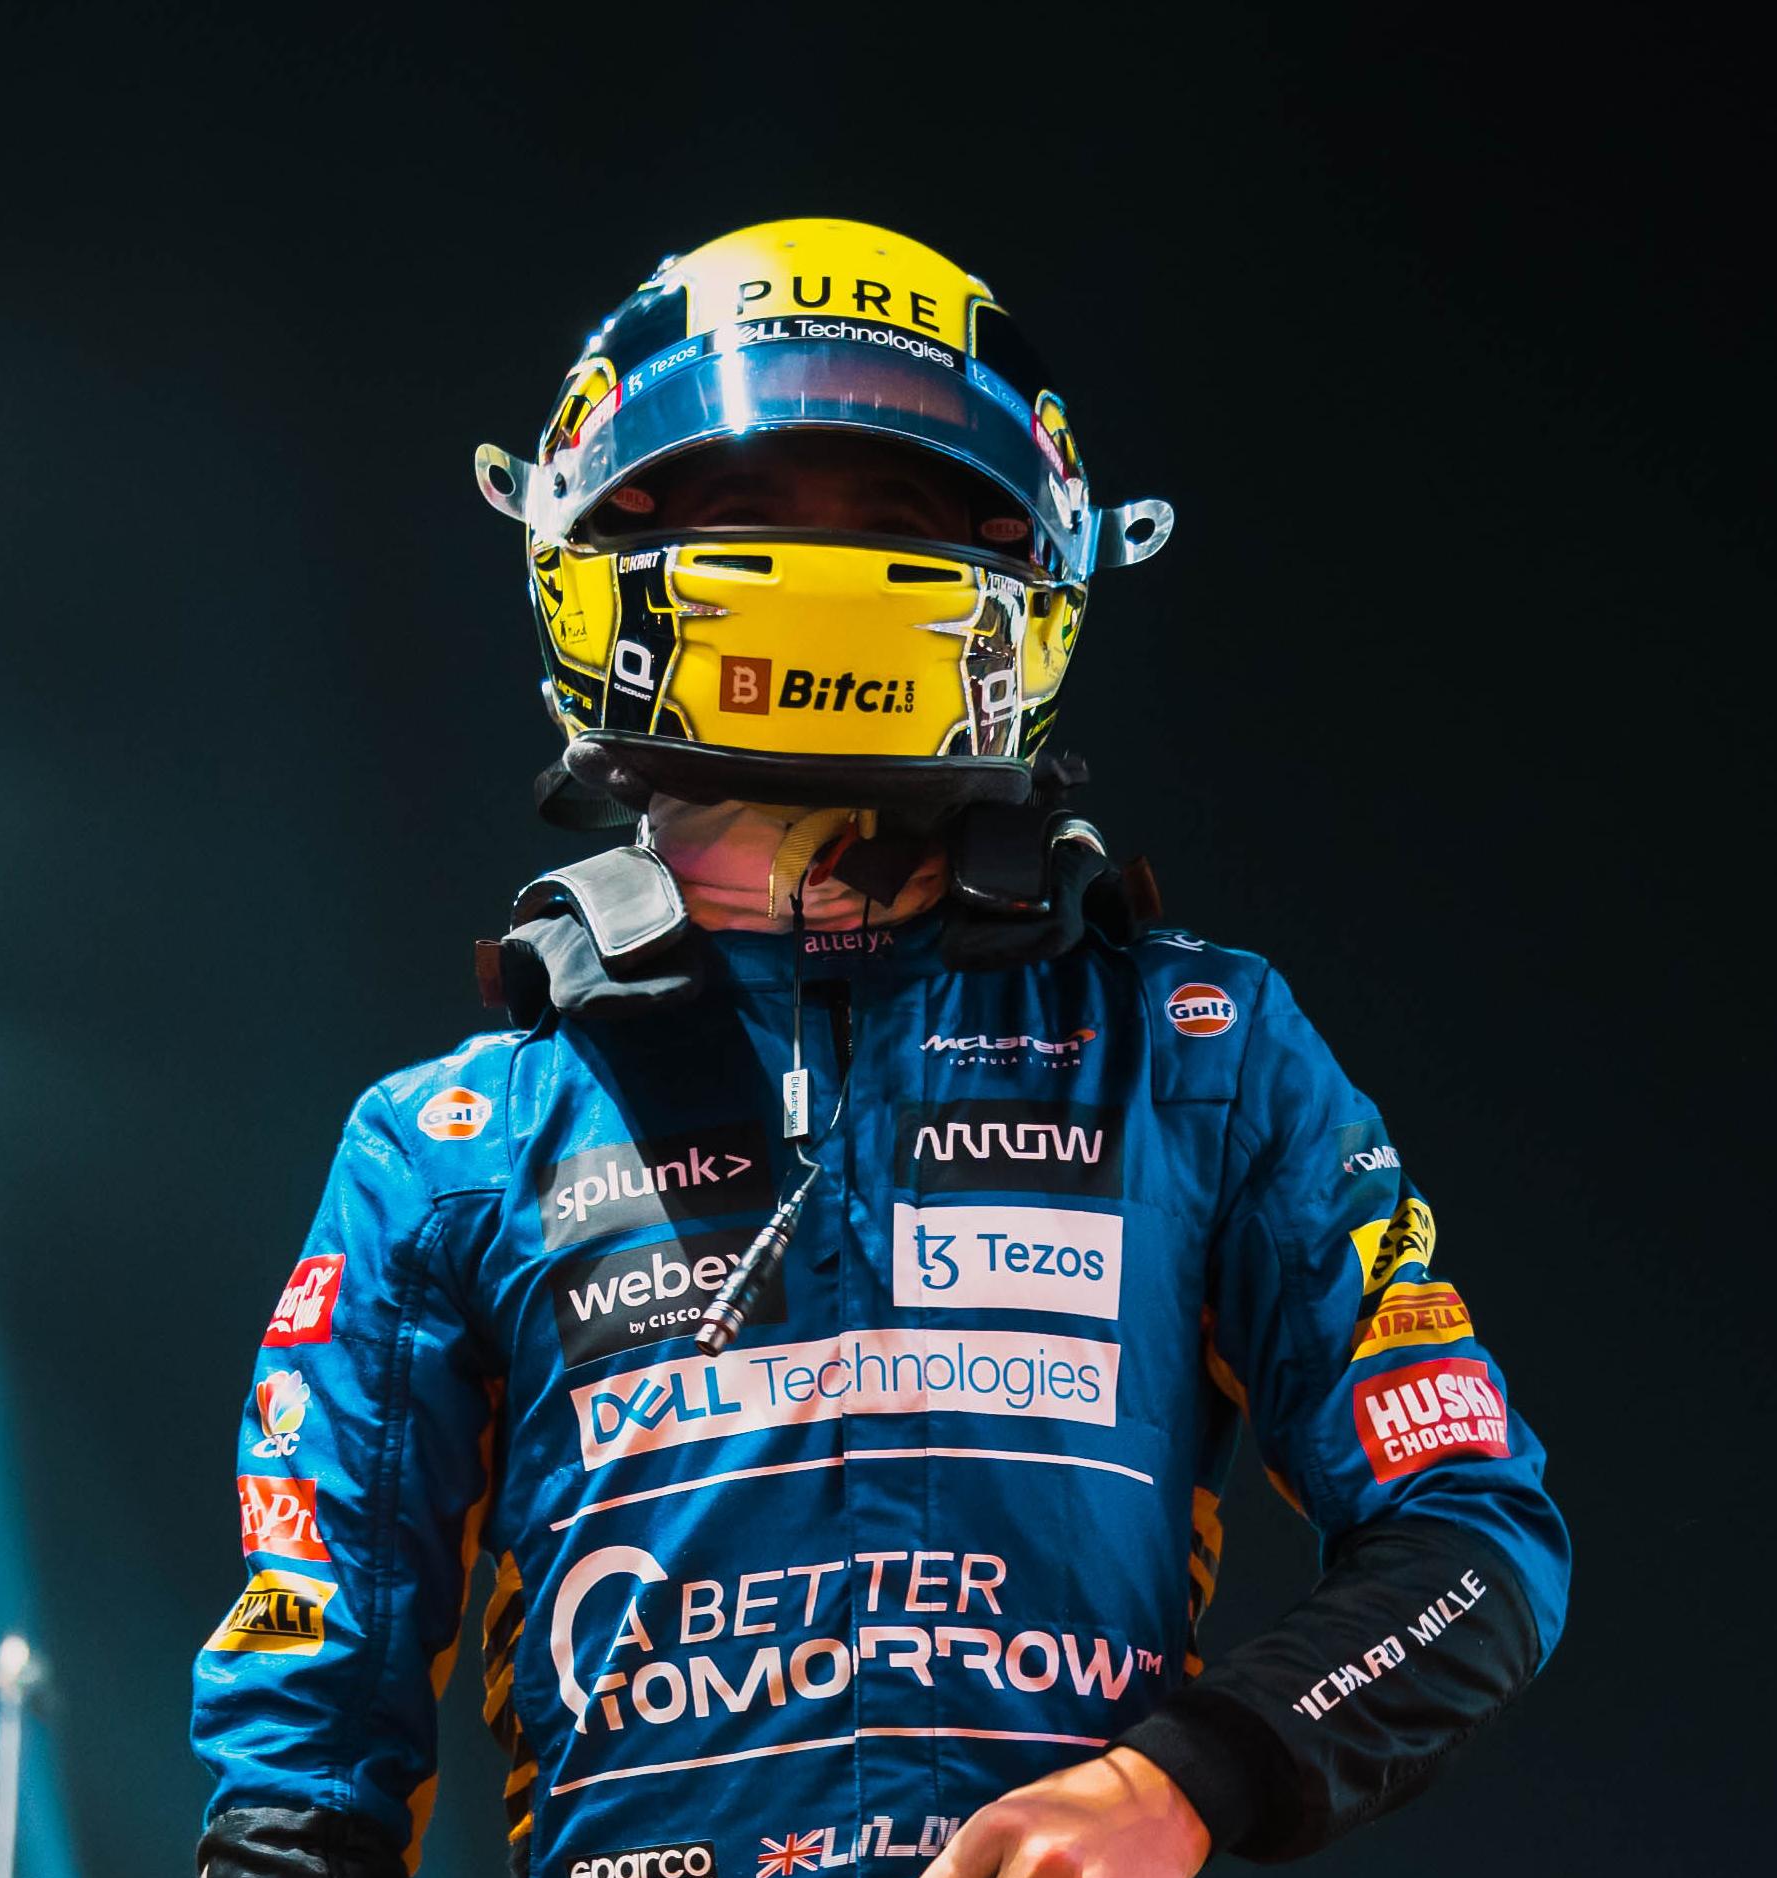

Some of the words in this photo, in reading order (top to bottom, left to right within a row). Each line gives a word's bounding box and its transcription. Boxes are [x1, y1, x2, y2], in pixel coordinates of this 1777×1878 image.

[736, 276, 940, 333] PURE
[649, 345, 697, 377] Tezos
[795, 320, 955, 369] Technologies
[1169, 1001, 1232, 1020] Gulf
[920, 1034, 1080, 1055] McLaren
[949, 1056, 1018, 1067] FORMULA
[1043, 1059, 1082, 1069] TEAM
[423, 1104, 487, 1125] Gulf
[914, 1122, 1104, 1164] ARROW
[977, 1233, 1105, 1281] Tezos
[629, 1320, 647, 1335] by
[648, 1305, 703, 1330] CISCO
[591, 1366, 742, 1445] DELL
[749, 1342, 1101, 1409] Technologies
[1365, 1373, 1501, 1440] HUSKI
[679, 1551, 1008, 1645] BETTER
[1407, 1568, 1487, 1647] MILLE
